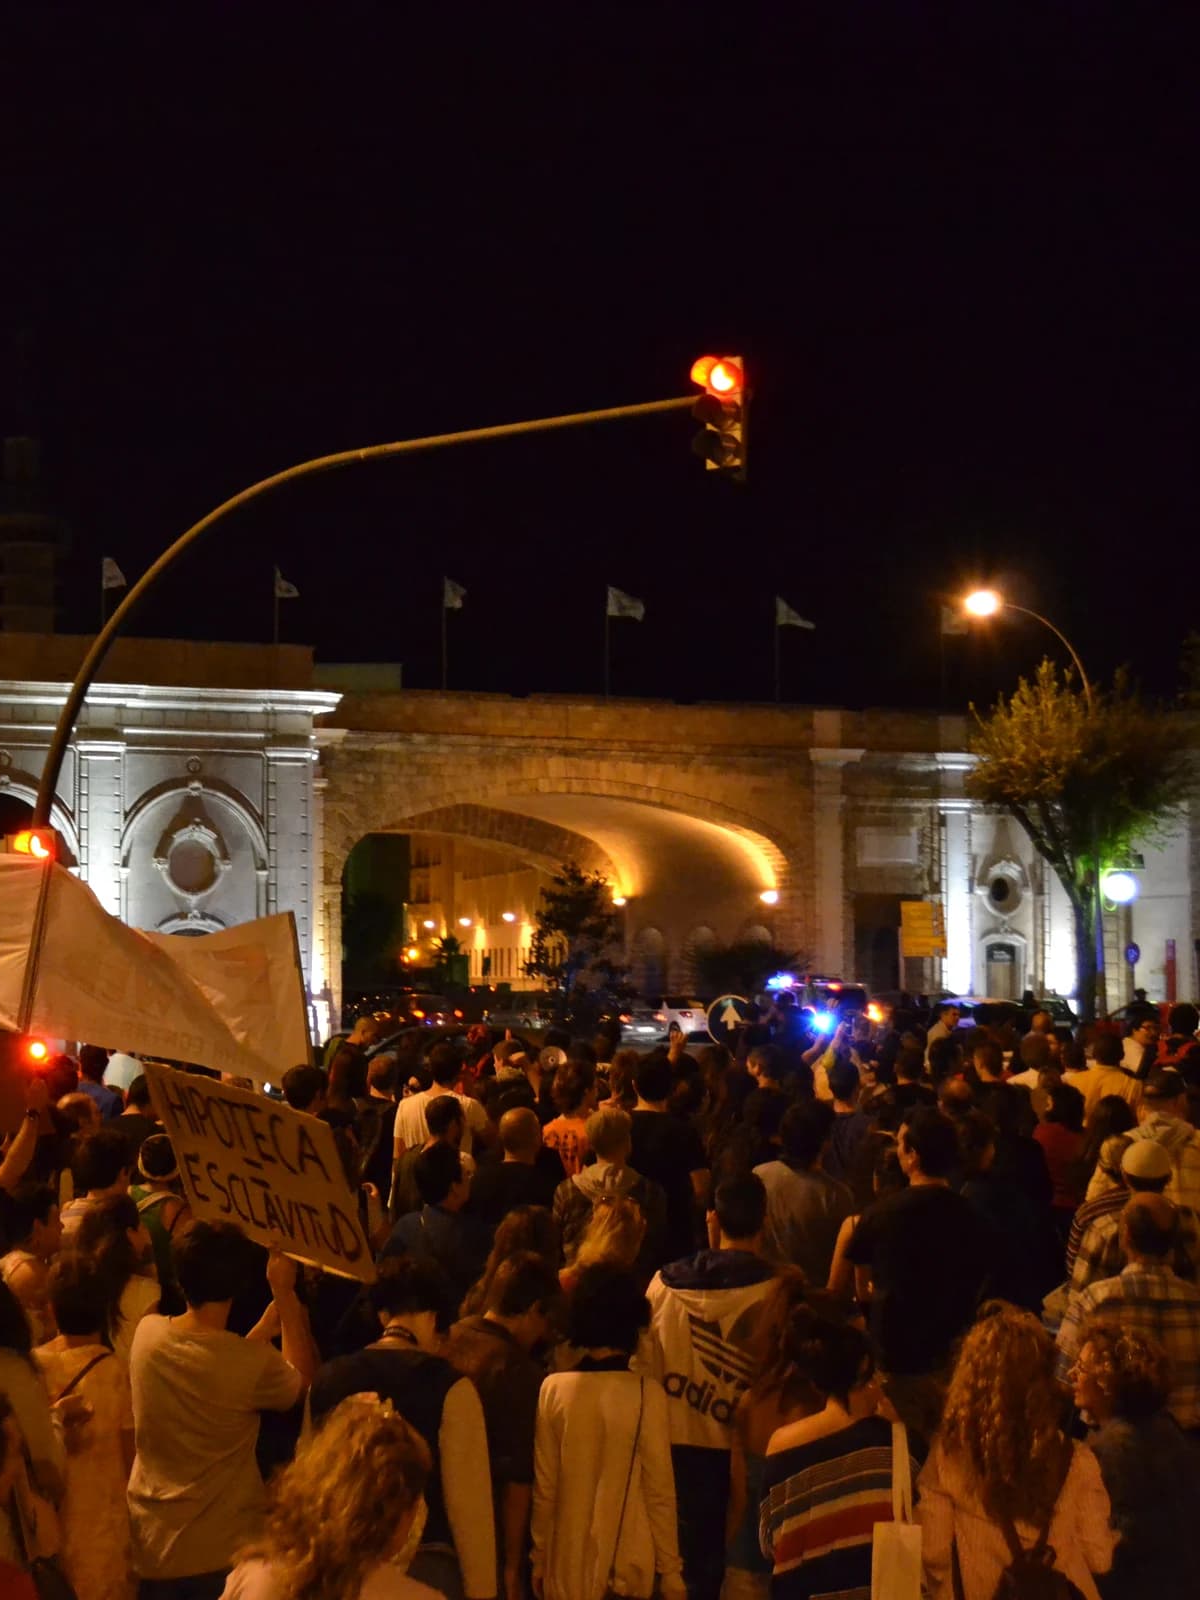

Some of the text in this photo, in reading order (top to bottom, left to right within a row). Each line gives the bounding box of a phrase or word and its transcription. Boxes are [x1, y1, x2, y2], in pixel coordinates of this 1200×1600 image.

[159, 1078, 331, 1183] HIPOTECA
[182, 1152, 361, 1262] ESCLAVITUD
[663, 1372, 740, 1425] adid
